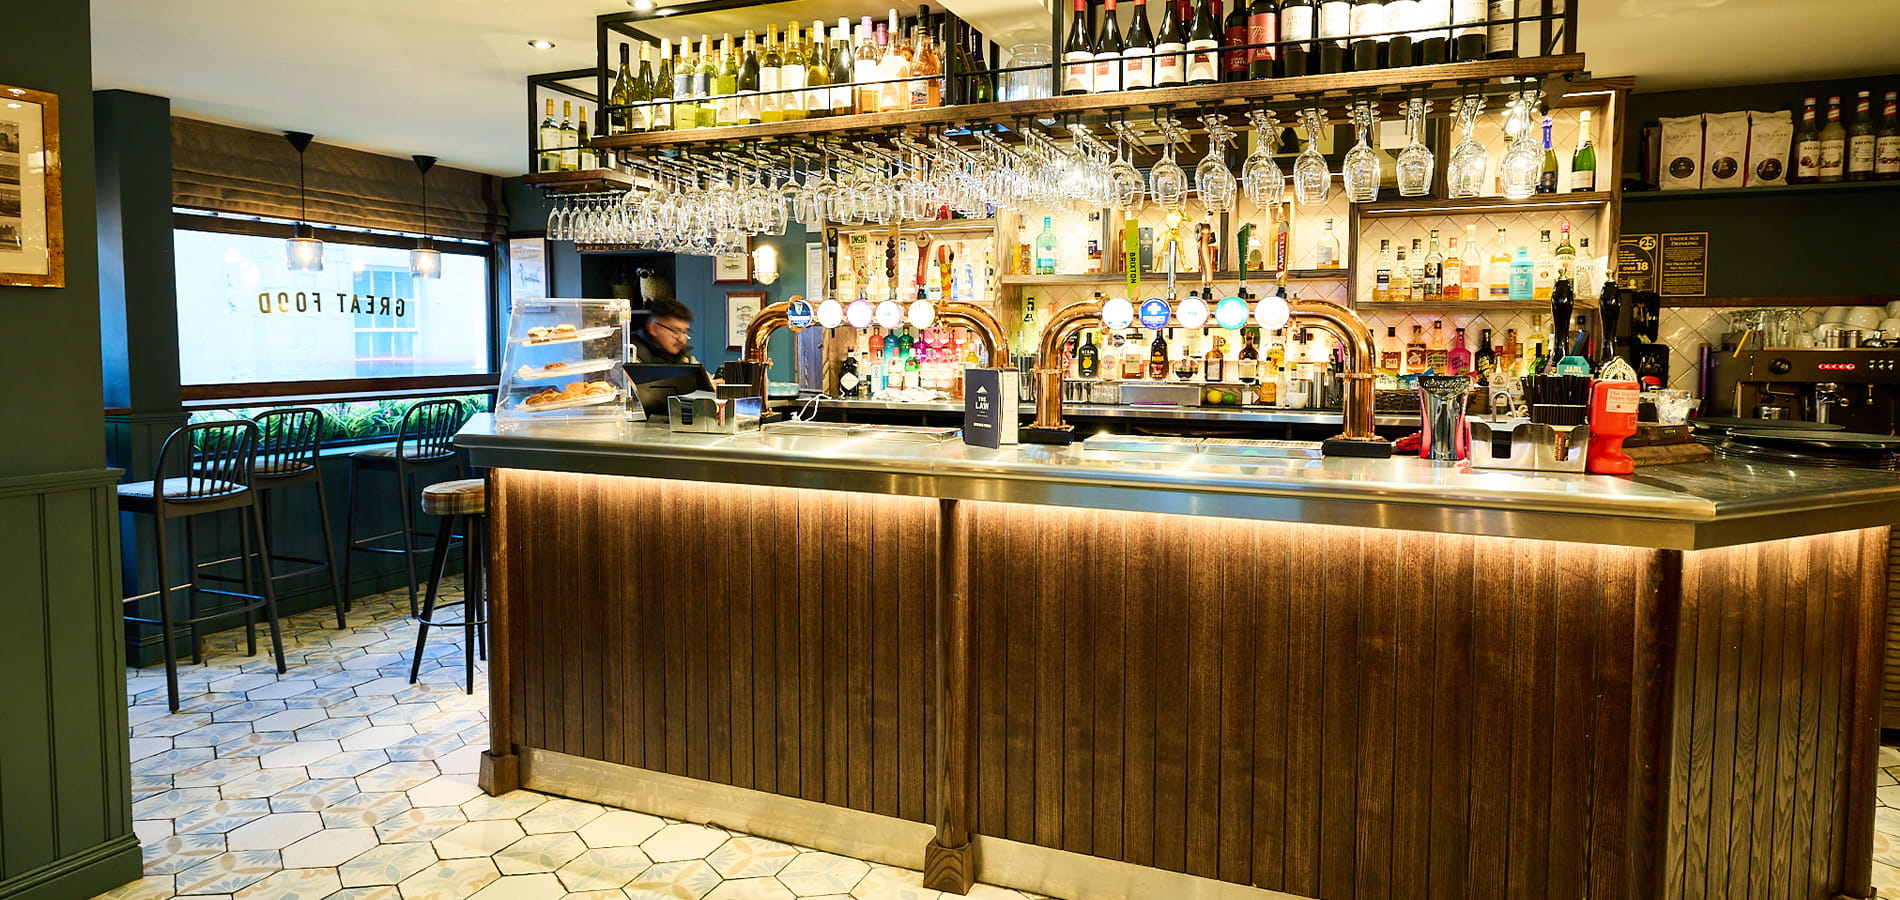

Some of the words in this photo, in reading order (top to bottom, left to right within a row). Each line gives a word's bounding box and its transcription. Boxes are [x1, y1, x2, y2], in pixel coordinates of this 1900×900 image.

[1641, 238, 1654, 247] 25
[1129, 252, 1137, 284] BRIXTON
[1636, 261, 1649, 271] 18
[1564, 366, 1583, 374] JARL
[975, 401, 990, 411] LAW
